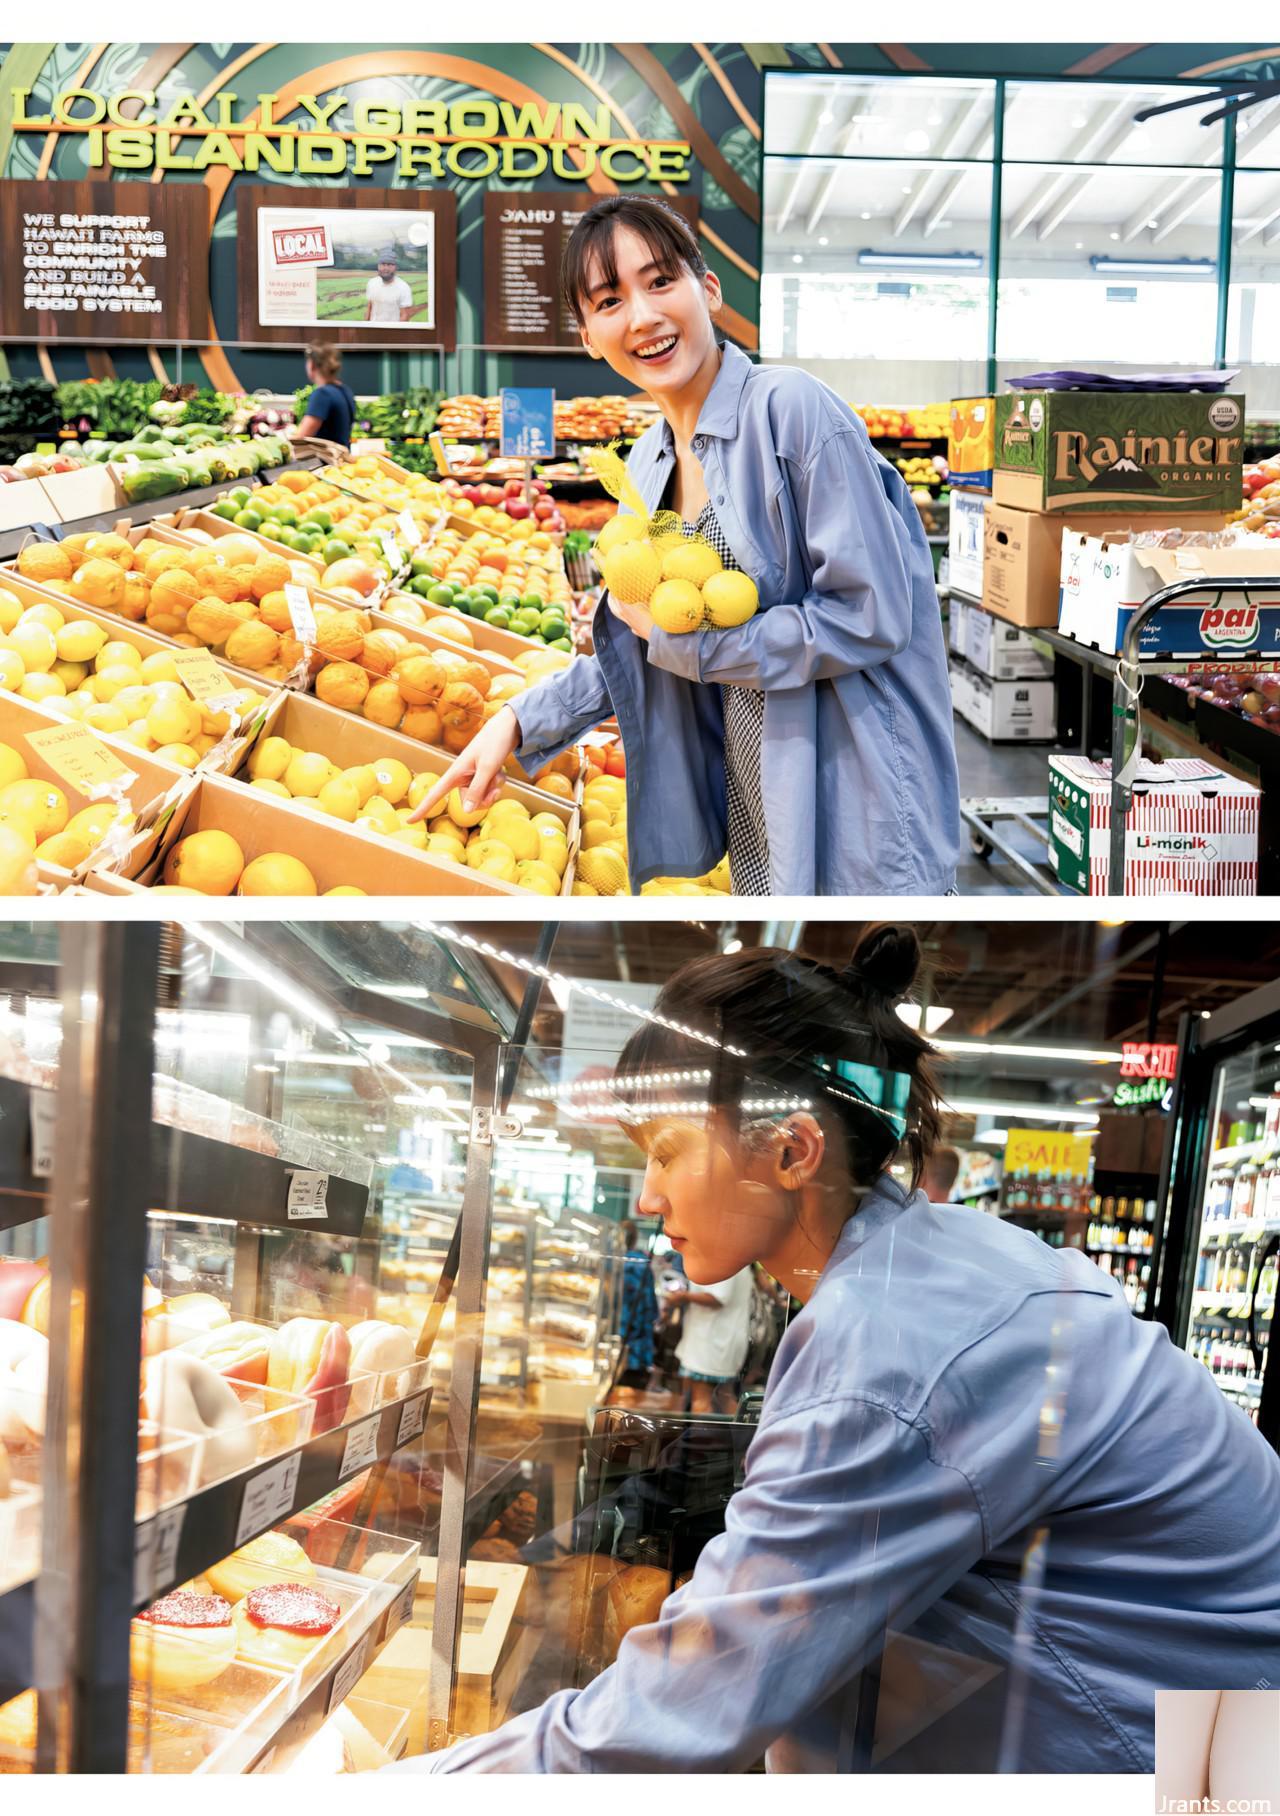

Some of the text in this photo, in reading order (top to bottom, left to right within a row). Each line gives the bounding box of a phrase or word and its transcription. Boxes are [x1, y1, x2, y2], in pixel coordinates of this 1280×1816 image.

[11, 87, 612, 141] LOCALLY GROWN
[88, 128, 690, 182] ISLAND PRODUCE
[23, 213, 150, 229] WE SUPPORT
[100, 229, 164, 243] FARMS
[275, 231, 326, 257] LOCAL
[23, 241, 167, 258] TO ENRICH THE
[23, 255, 142, 271] COMMUNITY
[24, 269, 146, 285] AND BUILD A
[23, 283, 156, 299] SUSTAINABLE
[23, 296, 162, 312] FOOD SYSTEM
[1052, 428, 1241, 483] Rainier
[1160, 471, 1231, 481] ORGANIC
[1200, 605, 1257, 632] pai
[1214, 628, 1246, 636] ARGENTINA
[1113, 1077, 1167, 1107] Sushi
